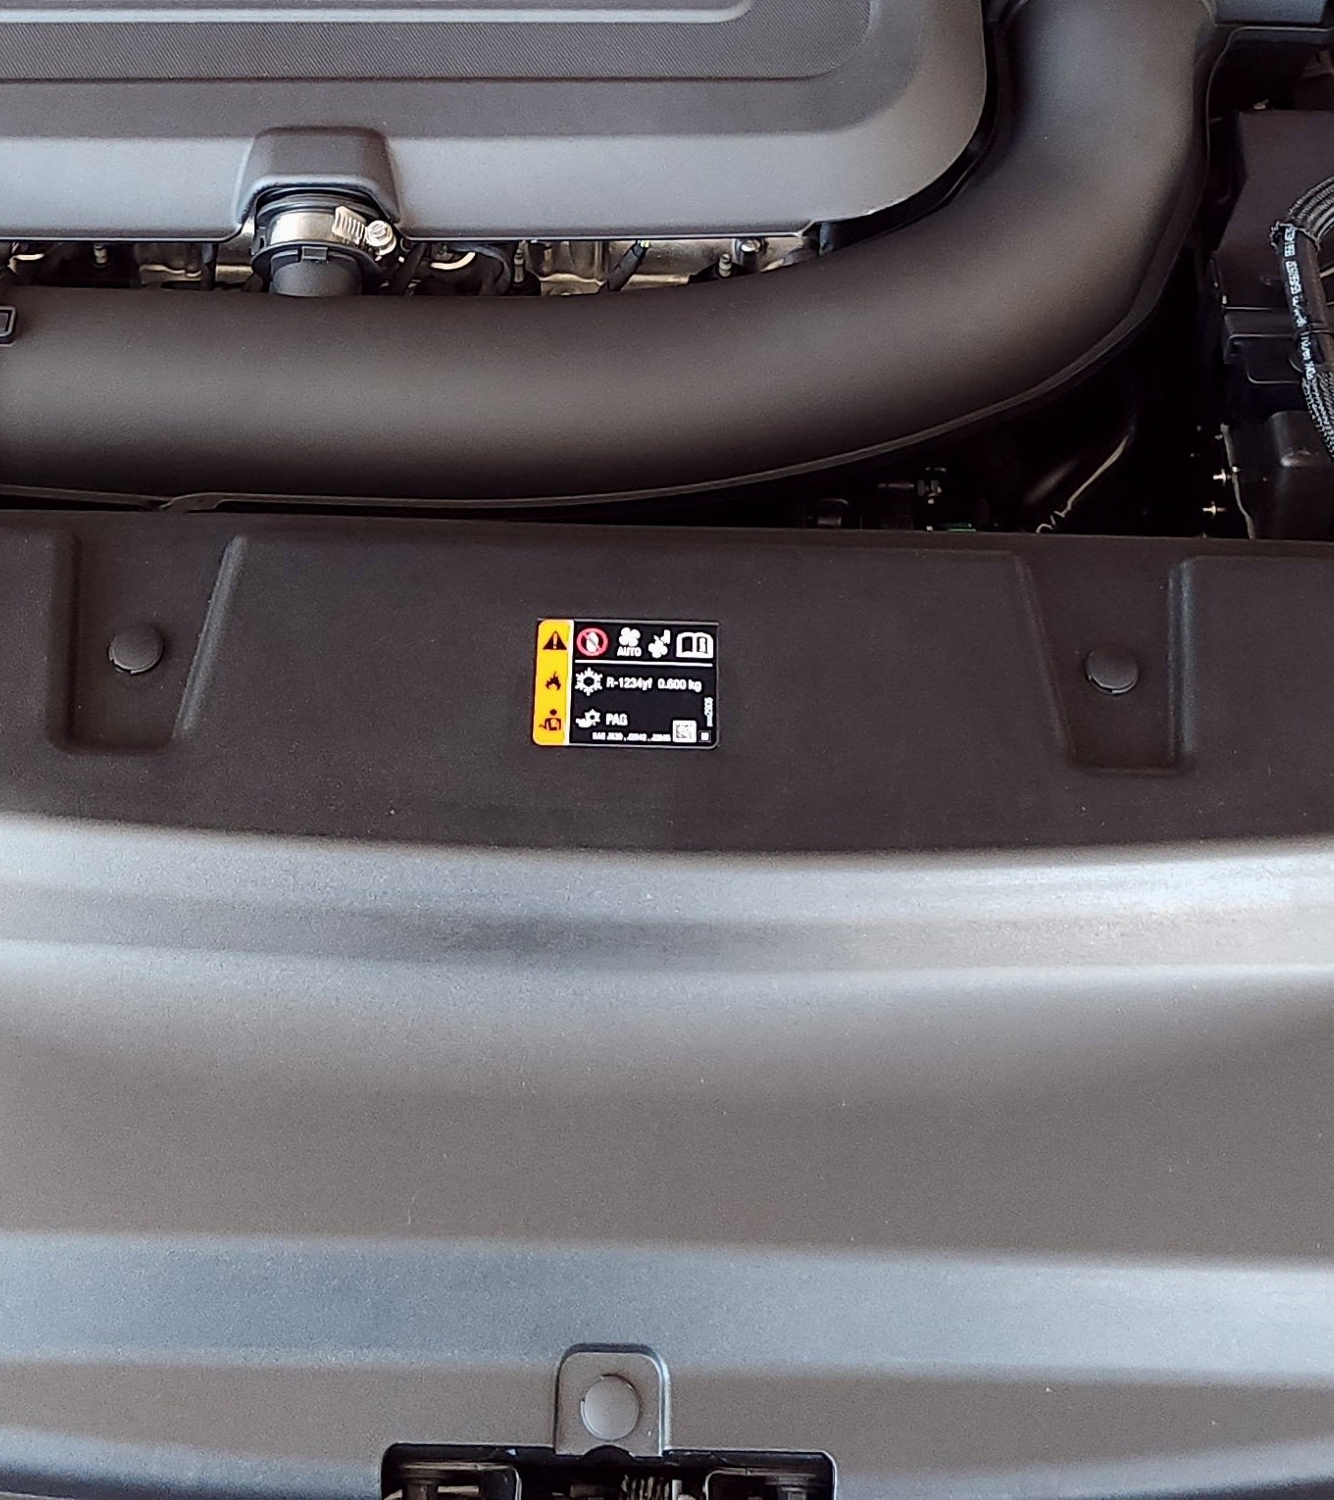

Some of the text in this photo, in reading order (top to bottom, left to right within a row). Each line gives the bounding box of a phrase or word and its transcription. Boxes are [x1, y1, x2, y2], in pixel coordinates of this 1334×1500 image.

[617, 647, 642, 657] AUTO
[606, 677, 702, 693] R-1234yf 0.600 kg
[605, 713, 628, 726] PAG
